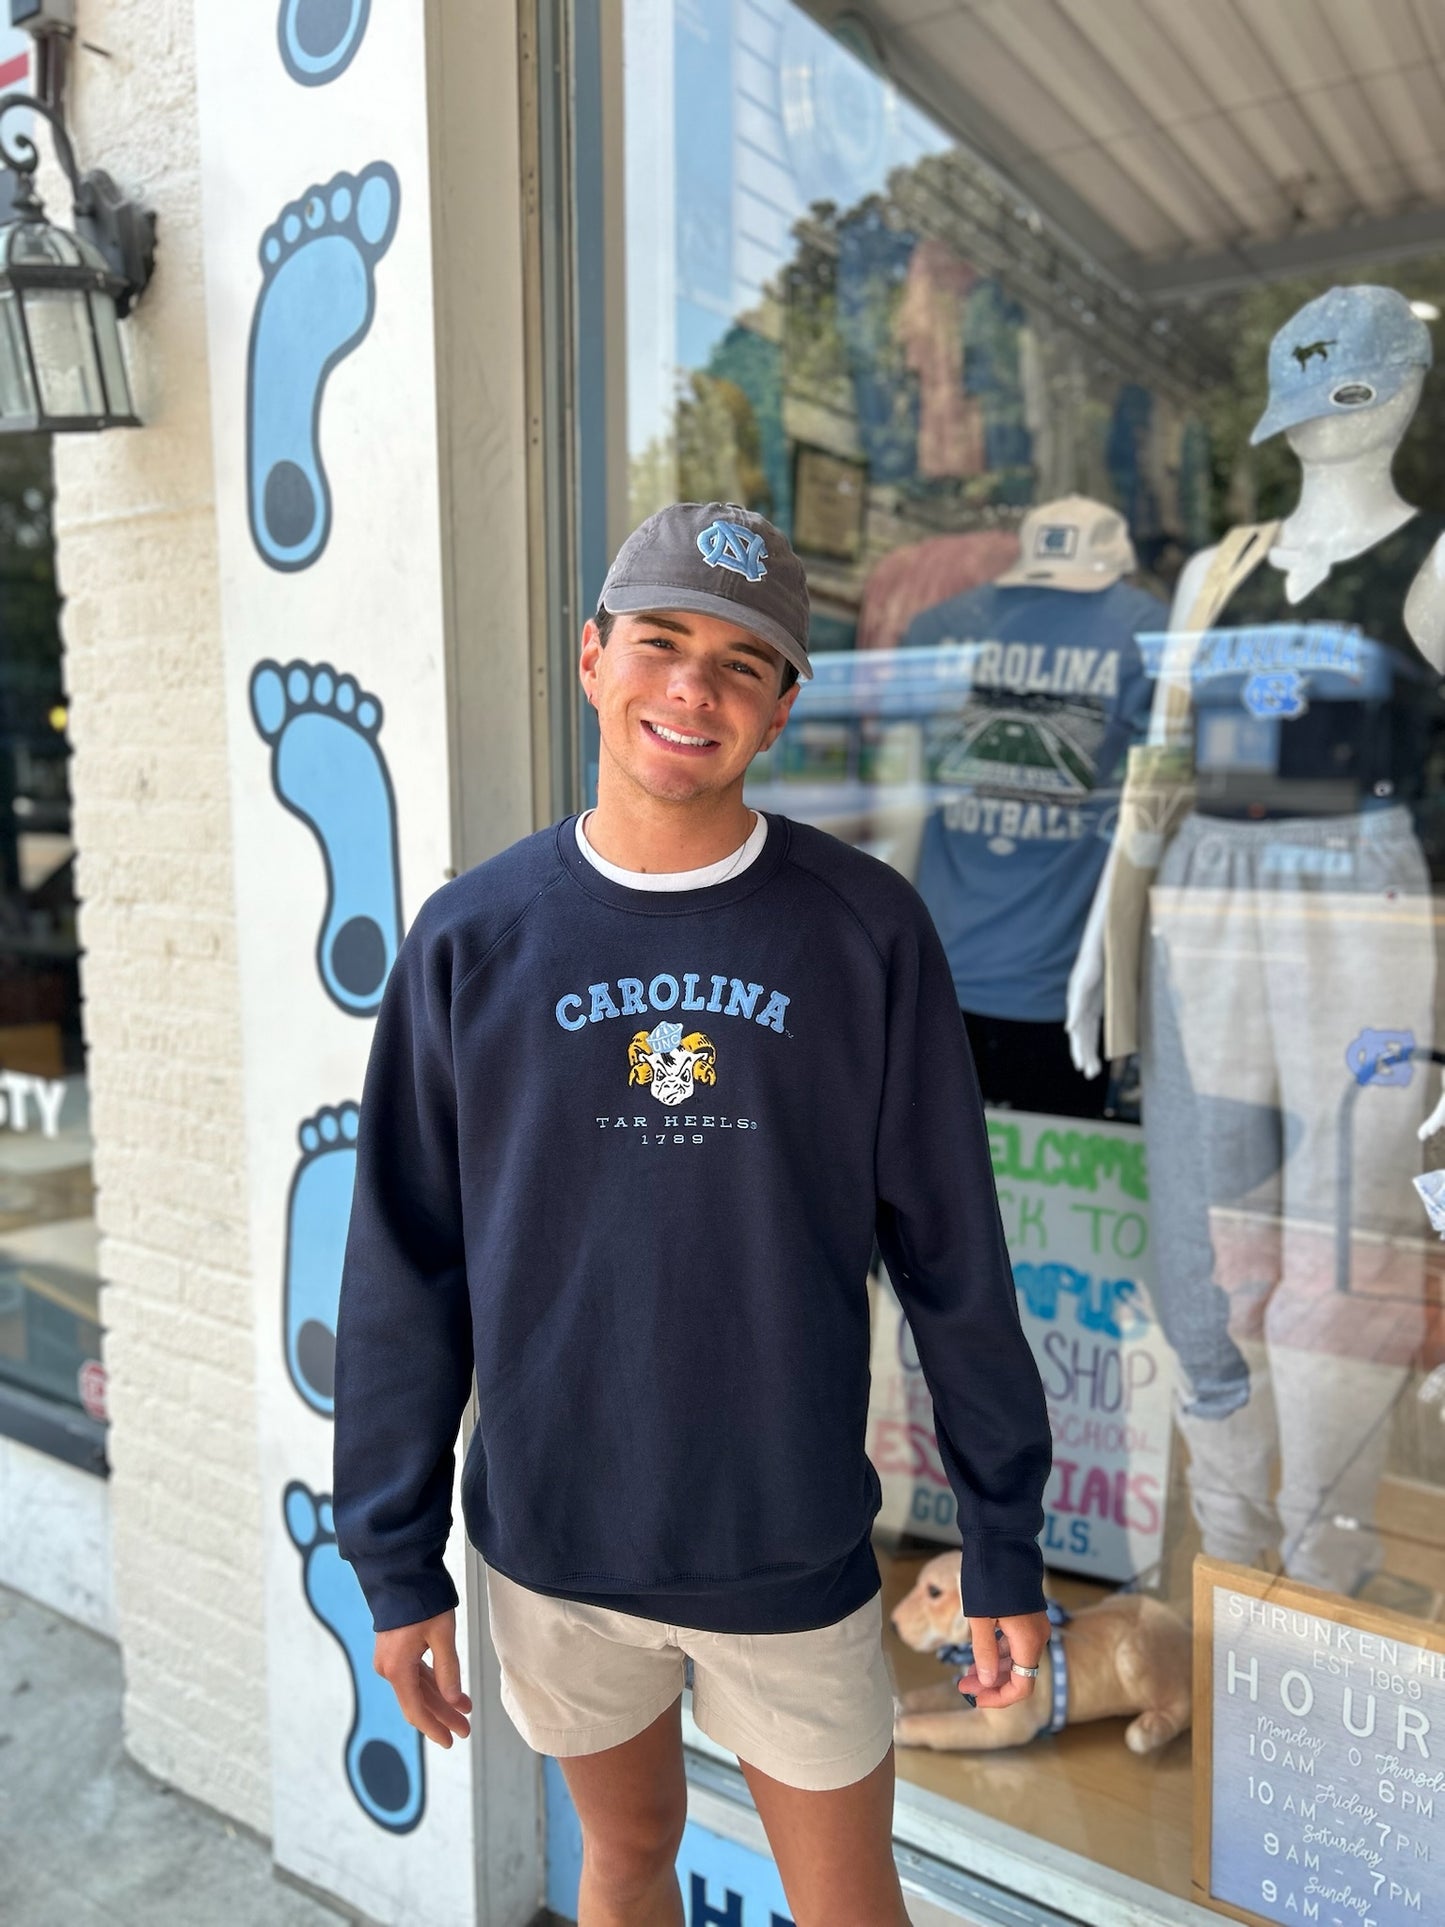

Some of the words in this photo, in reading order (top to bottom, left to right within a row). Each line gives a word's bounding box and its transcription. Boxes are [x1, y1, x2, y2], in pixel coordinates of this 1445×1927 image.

[555, 973, 791, 1033] CAROLINA
[652, 1034, 681, 1052] UNC
[596, 1116, 648, 1129] TAR
[641, 1134, 704, 1145] 1789
[986, 1120, 1149, 1202] ELCOME
[1070, 1203, 1149, 1260] TO
[1042, 1330, 1158, 1414] SHOP
[1228, 1594, 1398, 1666] SHRUNKEN
[1313, 1650, 1354, 1678] EST
[1369, 1667, 1422, 1700] 1969
[1256, 1715, 1326, 1758] Monday
[1249, 1733, 1277, 1762] 10
[1282, 1750, 1315, 1776] AM
[1378, 1779, 1395, 1804] 6
[1401, 1790, 1434, 1819] PM
[1248, 1776, 1274, 1805] 10
[1283, 1794, 1316, 1821] AM
[1376, 1821, 1391, 1847] 7
[1396, 1833, 1430, 1863] PM
[1315, 1783, 1378, 1825] Friday
[1263, 1832, 1279, 1856] 9
[1286, 1845, 1320, 1872] AM
[1370, 1870, 1386, 1895] 7
[1389, 1881, 1422, 1911] PM
[1302, 1824, 1383, 1869] Saturday
[1261, 1879, 1277, 1903] 9
[1285, 1892, 1319, 1921] AM
[1303, 1876, 1371, 1917] Sunday
